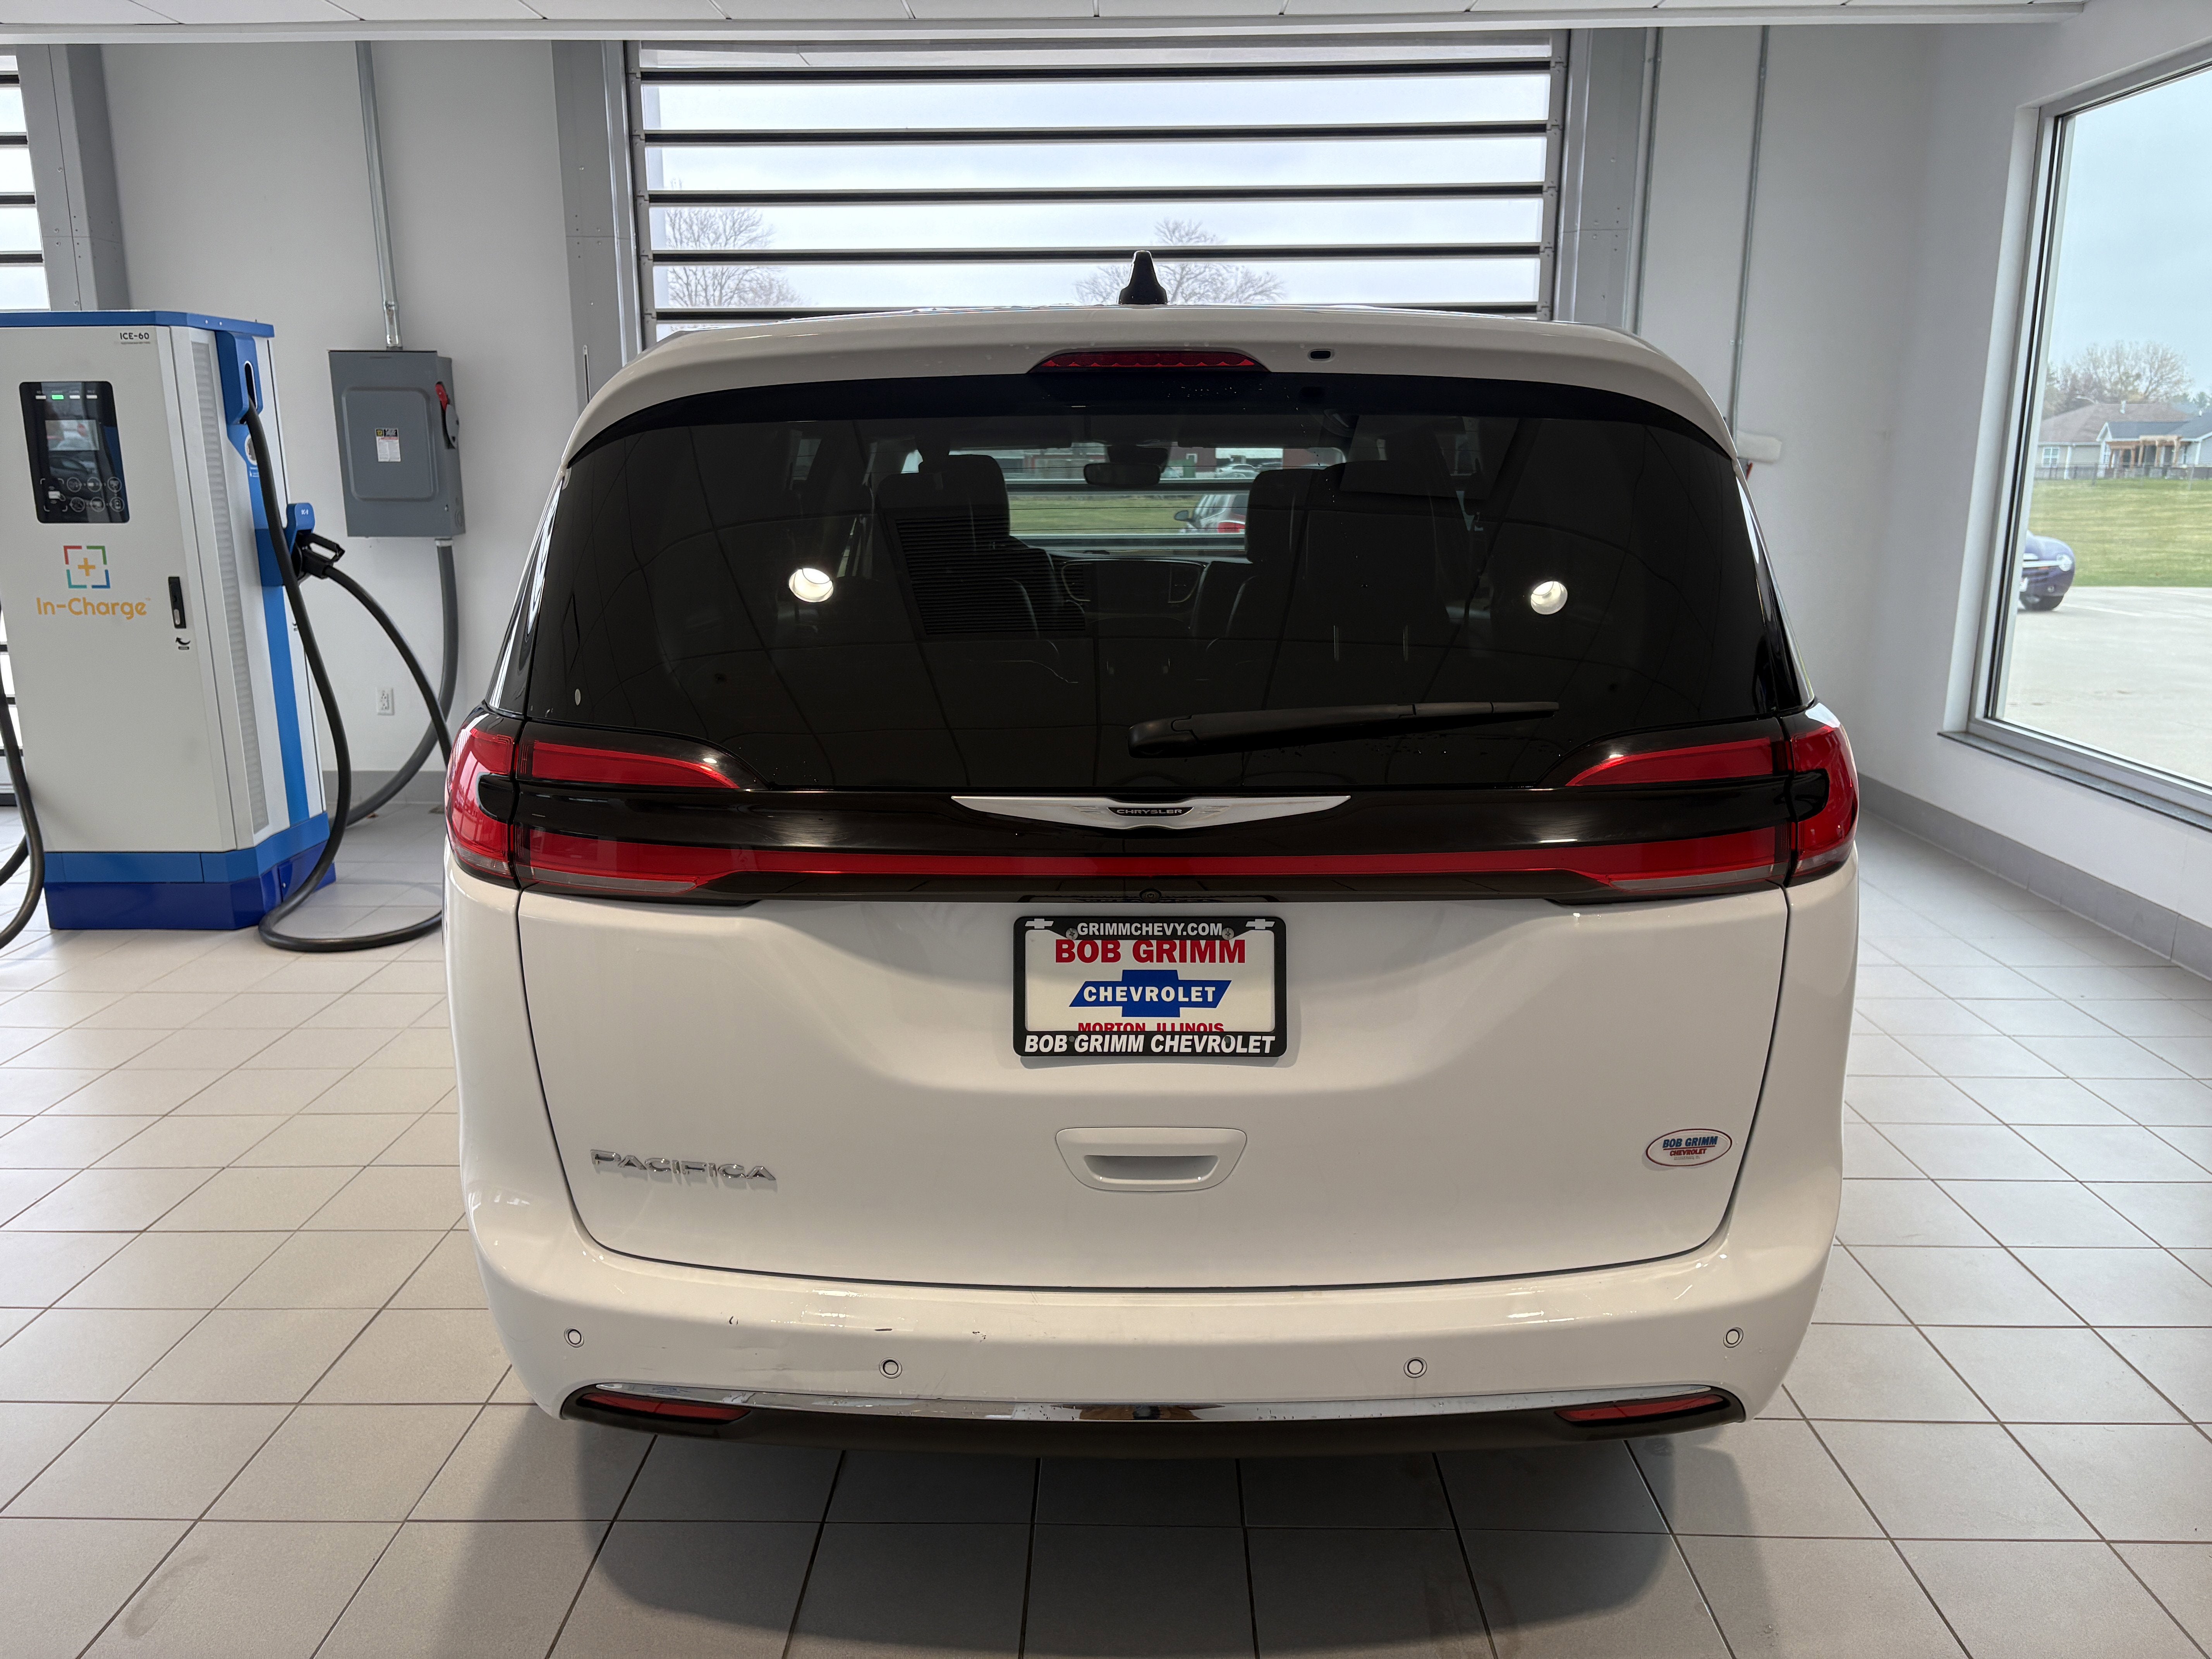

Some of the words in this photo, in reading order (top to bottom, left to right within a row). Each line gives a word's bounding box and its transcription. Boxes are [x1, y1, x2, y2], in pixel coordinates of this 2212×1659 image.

[36, 597, 147, 620] In-Charge
[1077, 922, 1222, 936] GRIMMCHEVY.COM
[1056, 939, 1121, 963] BOB
[1132, 939, 1245, 963] GRIMM
[1083, 986, 1216, 1002] CHEVROLET
[1025, 1035, 1068, 1052] BOB
[1074, 1035, 1144, 1052] GRIMM
[1151, 1035, 1276, 1053] CHEVROLET
[1663, 1139, 1682, 1148] BOB
[1685, 1136, 1718, 1146] GRIMM
[590, 1149, 776, 1181] PACIFICA
